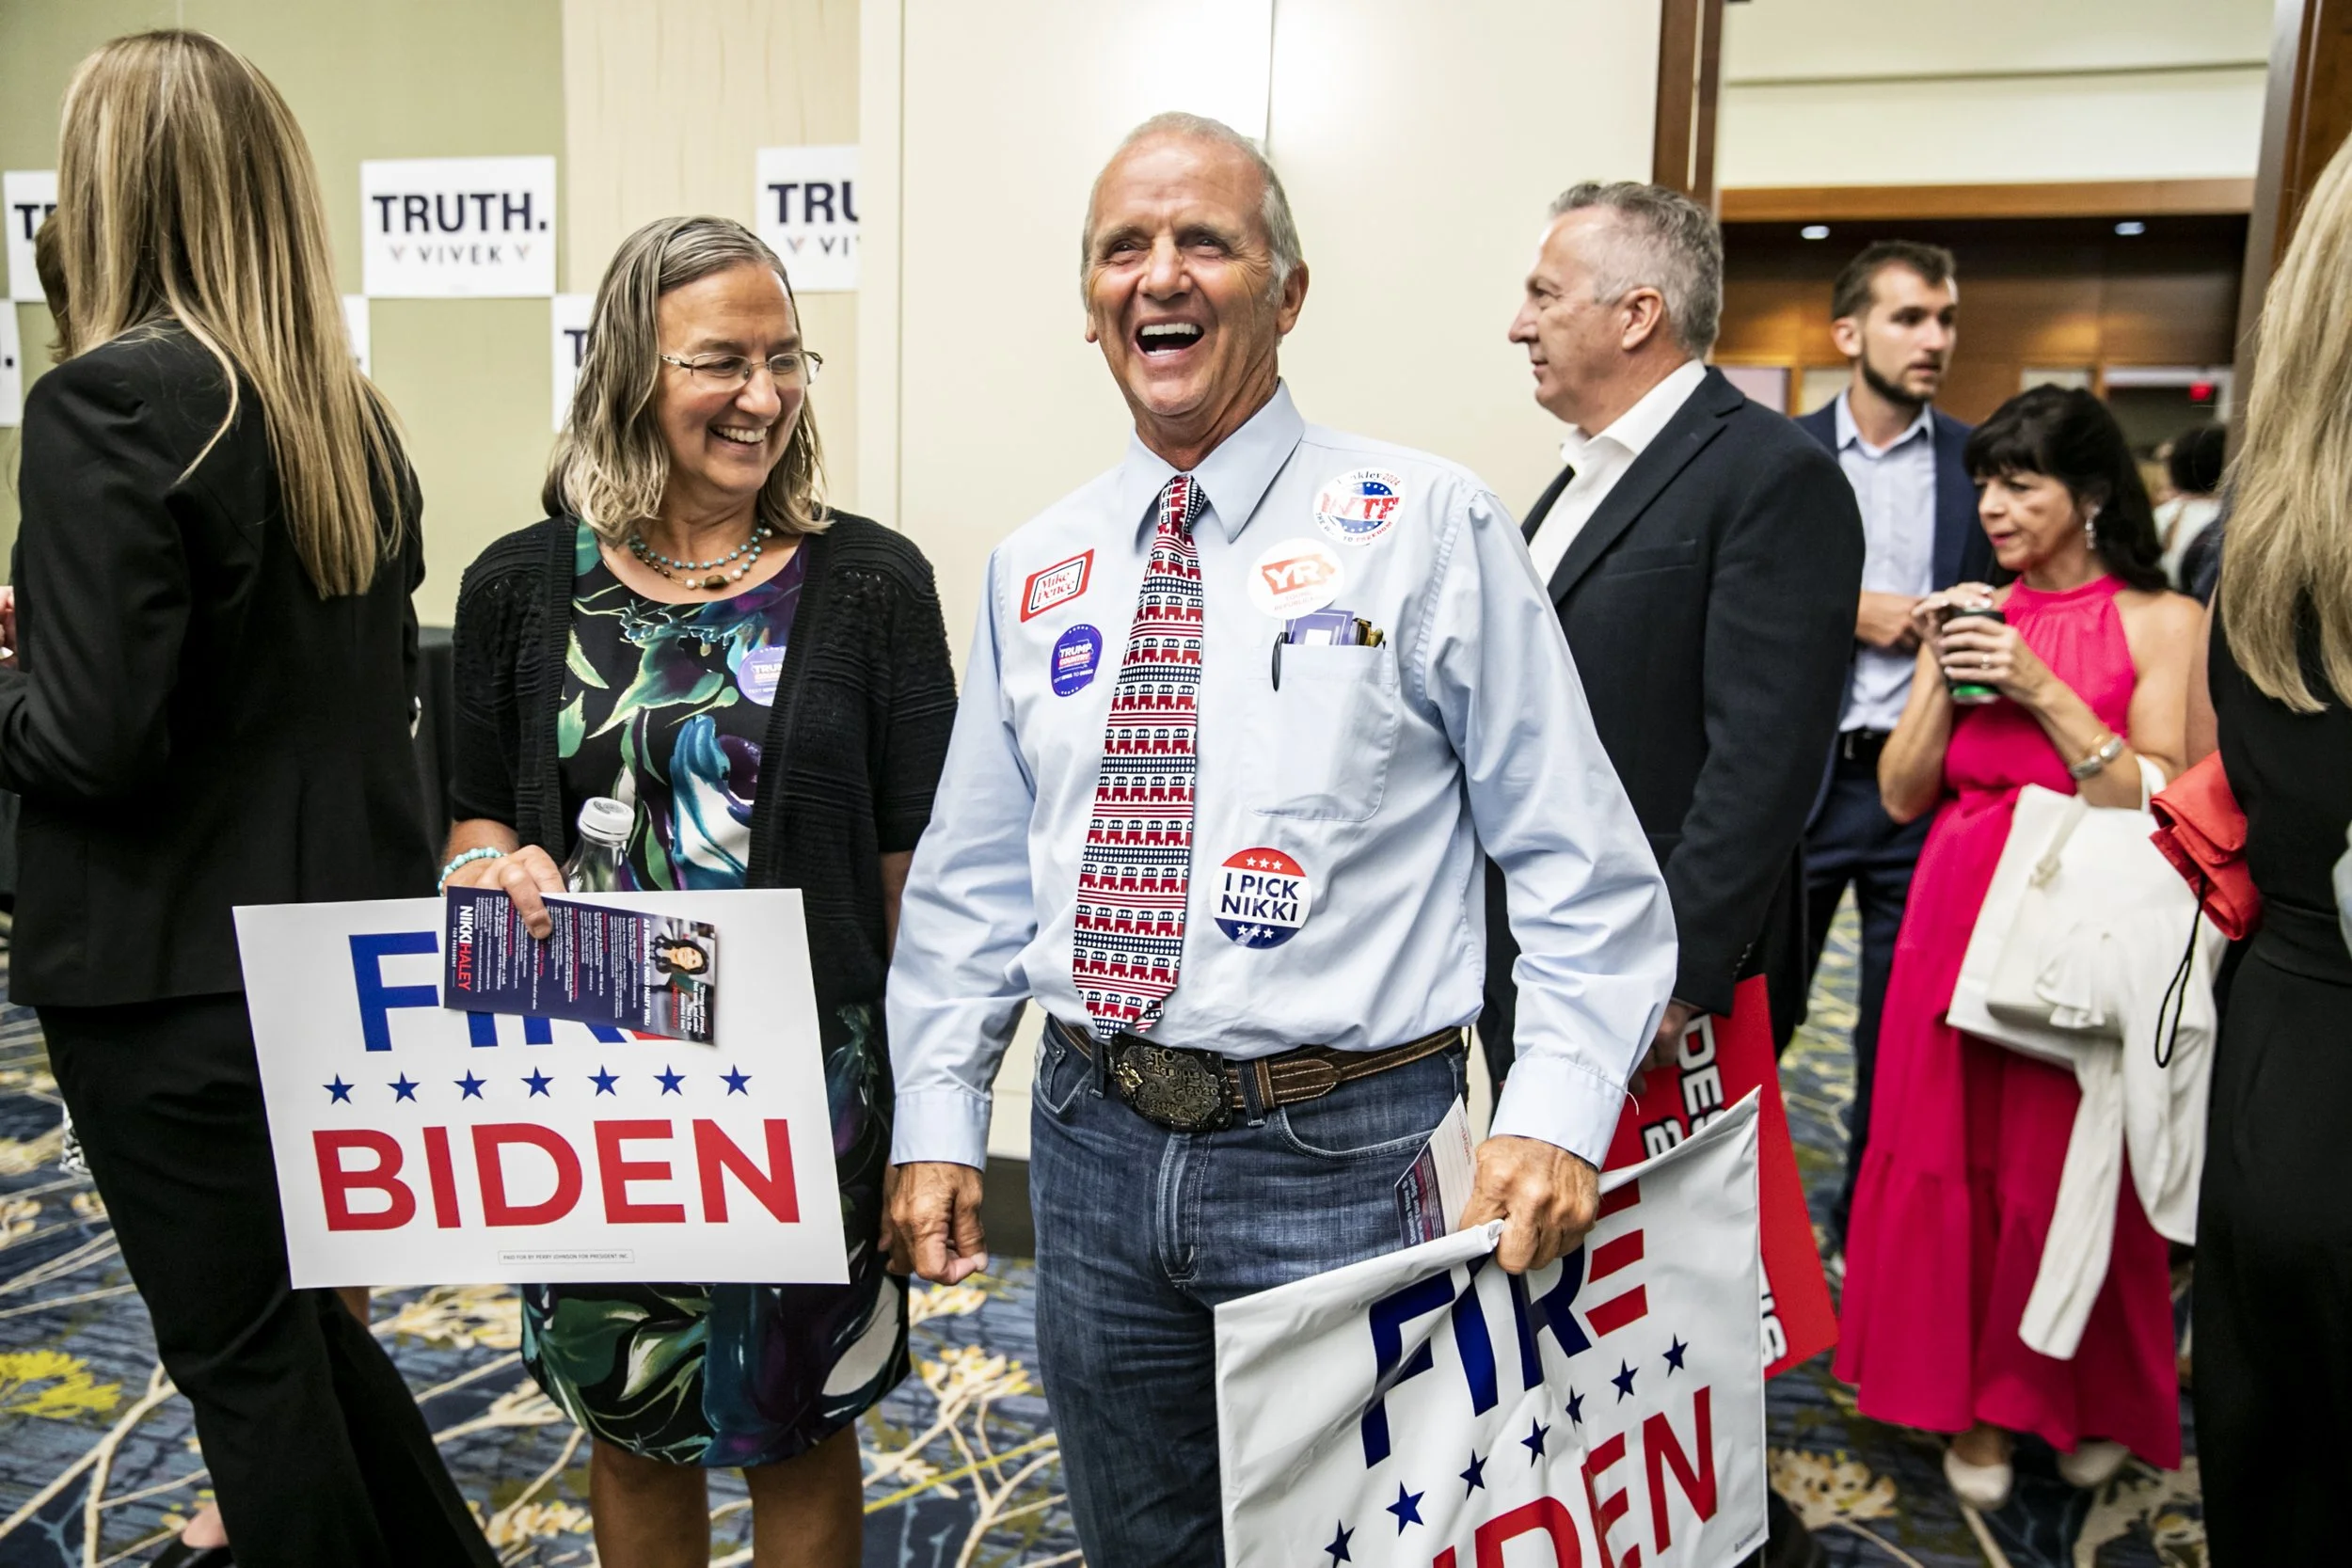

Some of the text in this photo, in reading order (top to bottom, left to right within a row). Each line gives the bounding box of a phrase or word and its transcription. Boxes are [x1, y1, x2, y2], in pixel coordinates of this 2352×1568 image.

[373, 193, 547, 232] TRUTH.
[419, 245, 501, 265] VIVEK
[1038, 580, 1074, 603] Pence
[1042, 572, 1070, 588] Mike
[1060, 642, 1093, 658] TRUMP
[1225, 873, 1299, 900] I PICK
[1221, 894, 1297, 922] NIKKI
[1187, 1086, 1218, 1096] 2020
[312, 1118, 801, 1232] BIDEN
